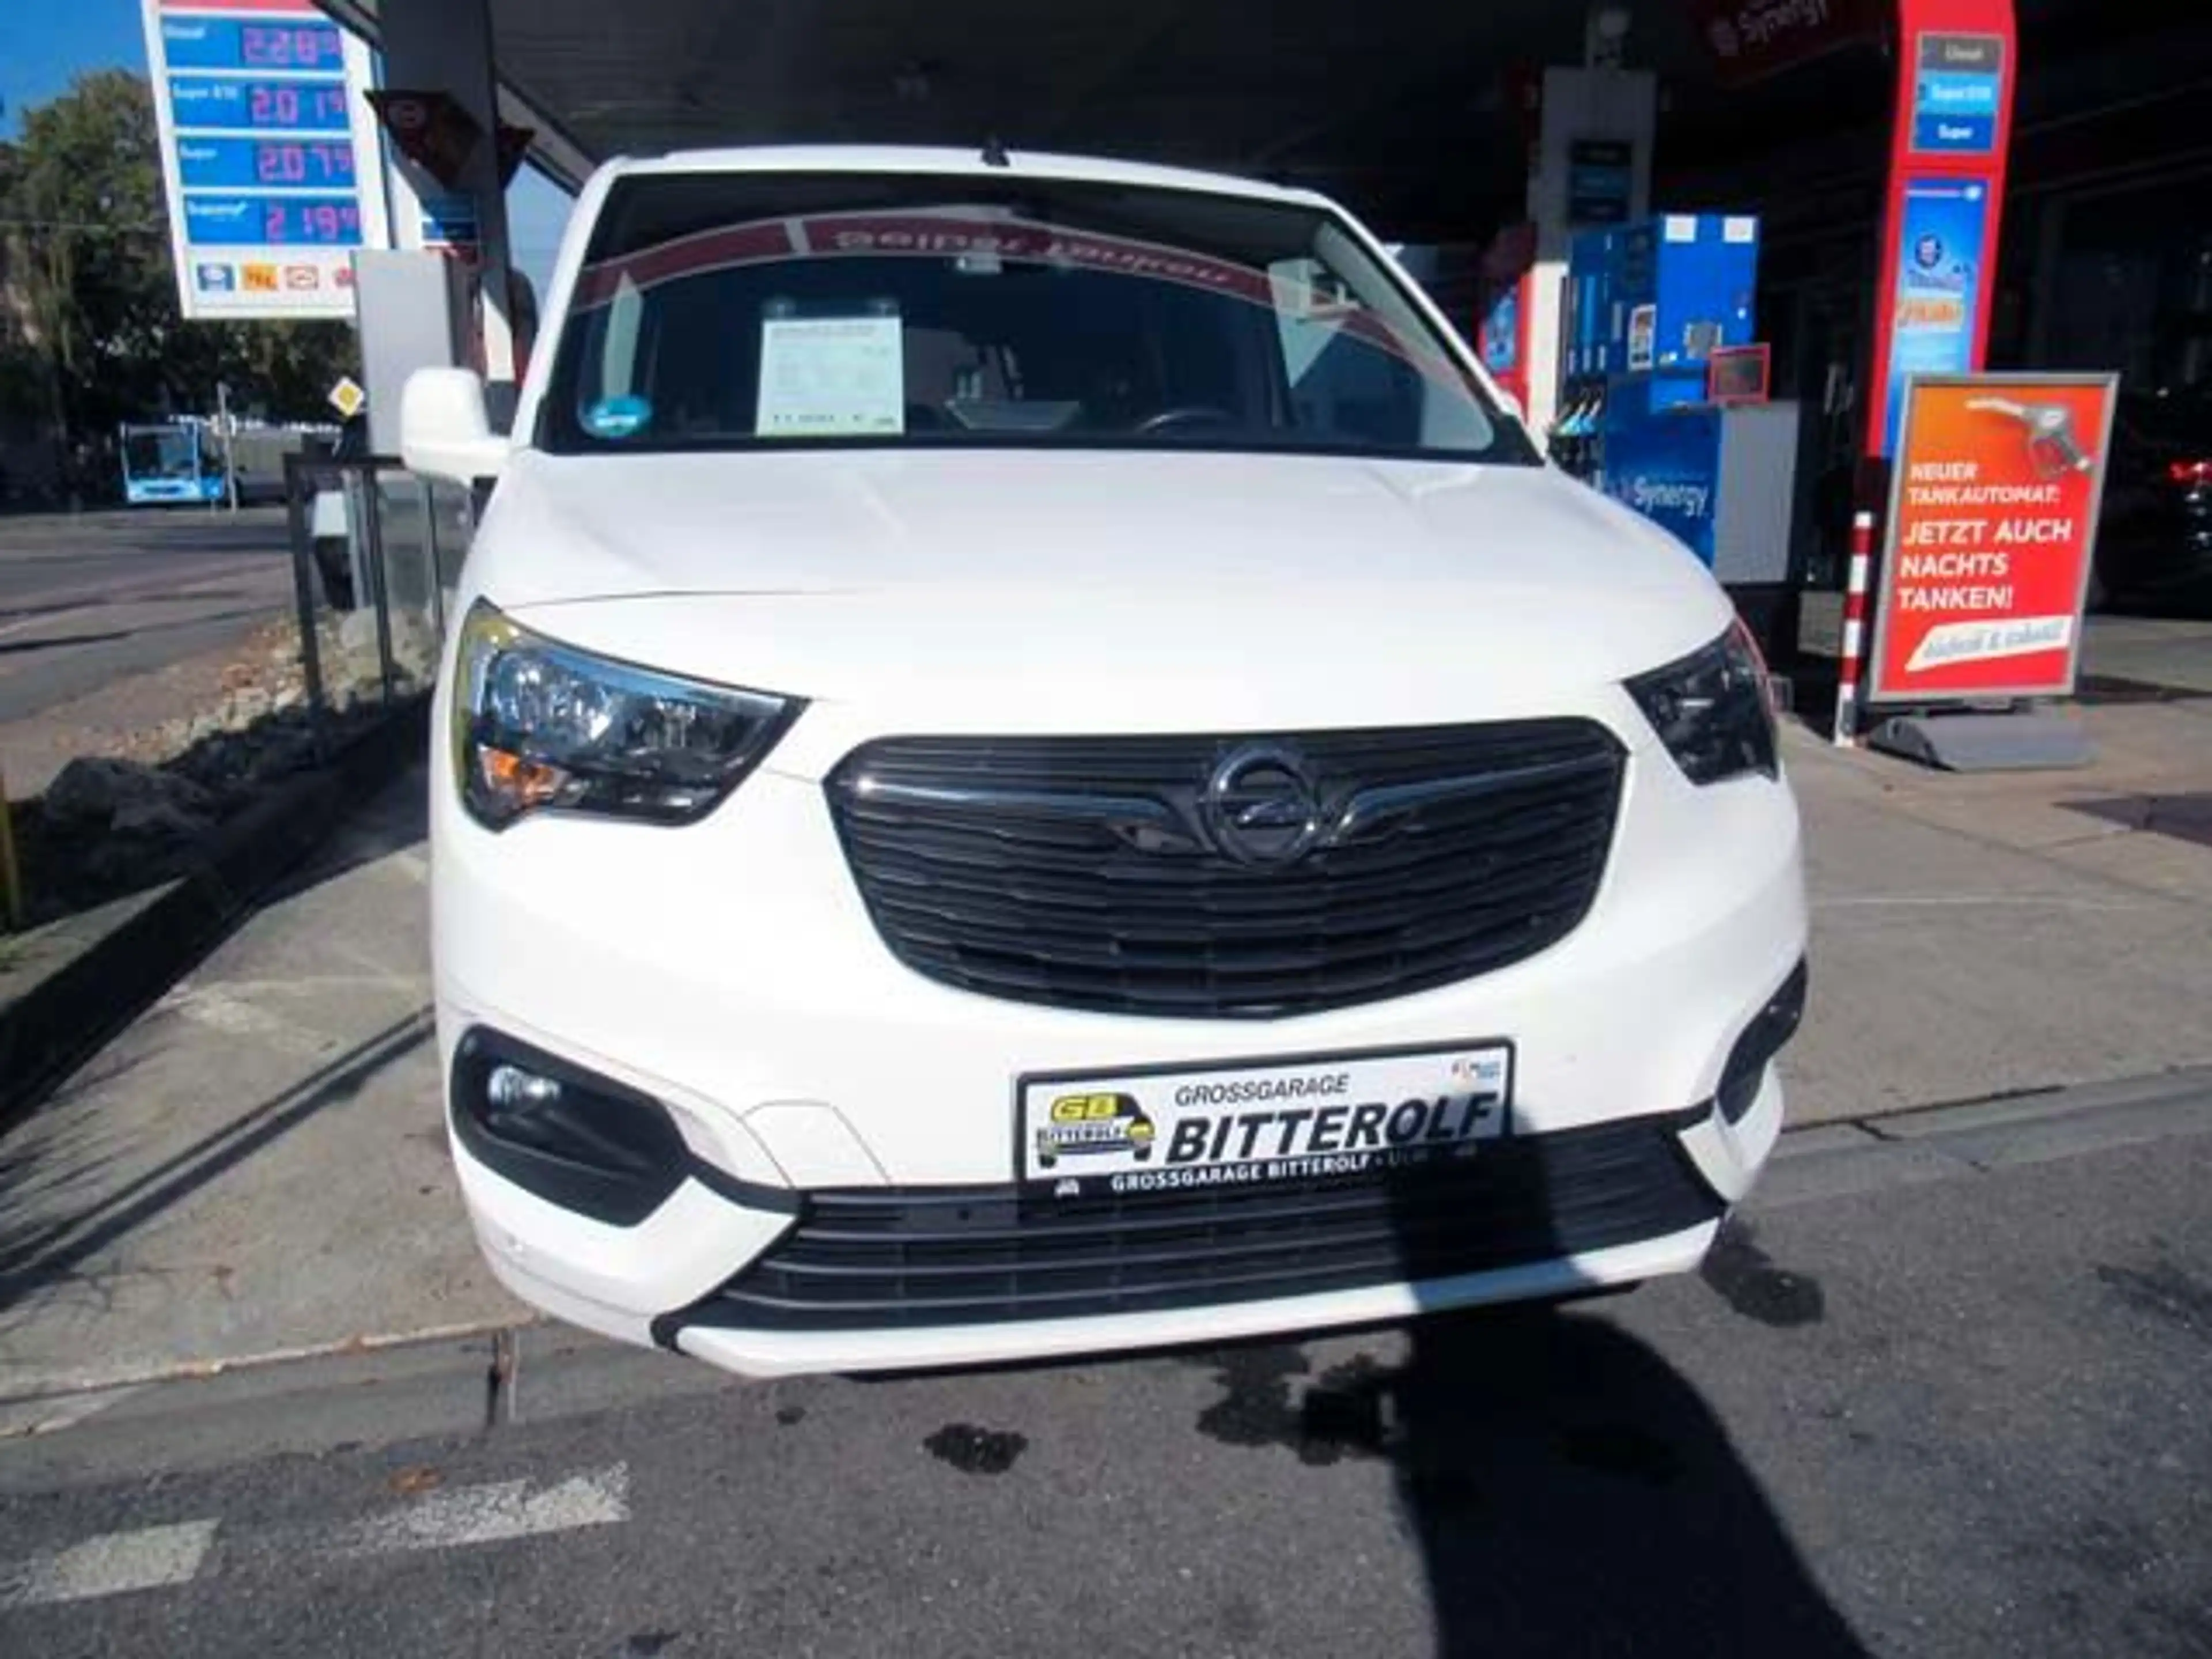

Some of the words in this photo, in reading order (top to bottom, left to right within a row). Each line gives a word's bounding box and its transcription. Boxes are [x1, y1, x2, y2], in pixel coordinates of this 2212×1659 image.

[1911, 463, 1978, 480] NEUER
[1634, 475, 1709, 519] Synergy
[1902, 521, 1987, 545] JETZT
[1994, 518, 2072, 544] AUCH
[1900, 552, 2009, 578] NACHTS
[1897, 585, 2014, 610] TANKEN!
[1175, 1074, 1350, 1107] GROSSGARAGE
[1165, 1091, 1498, 1164] BITTEROLF
[1111, 1162, 1262, 1192] GROSSGARAGE
[1268, 1153, 1370, 1180] BITTEROLF
